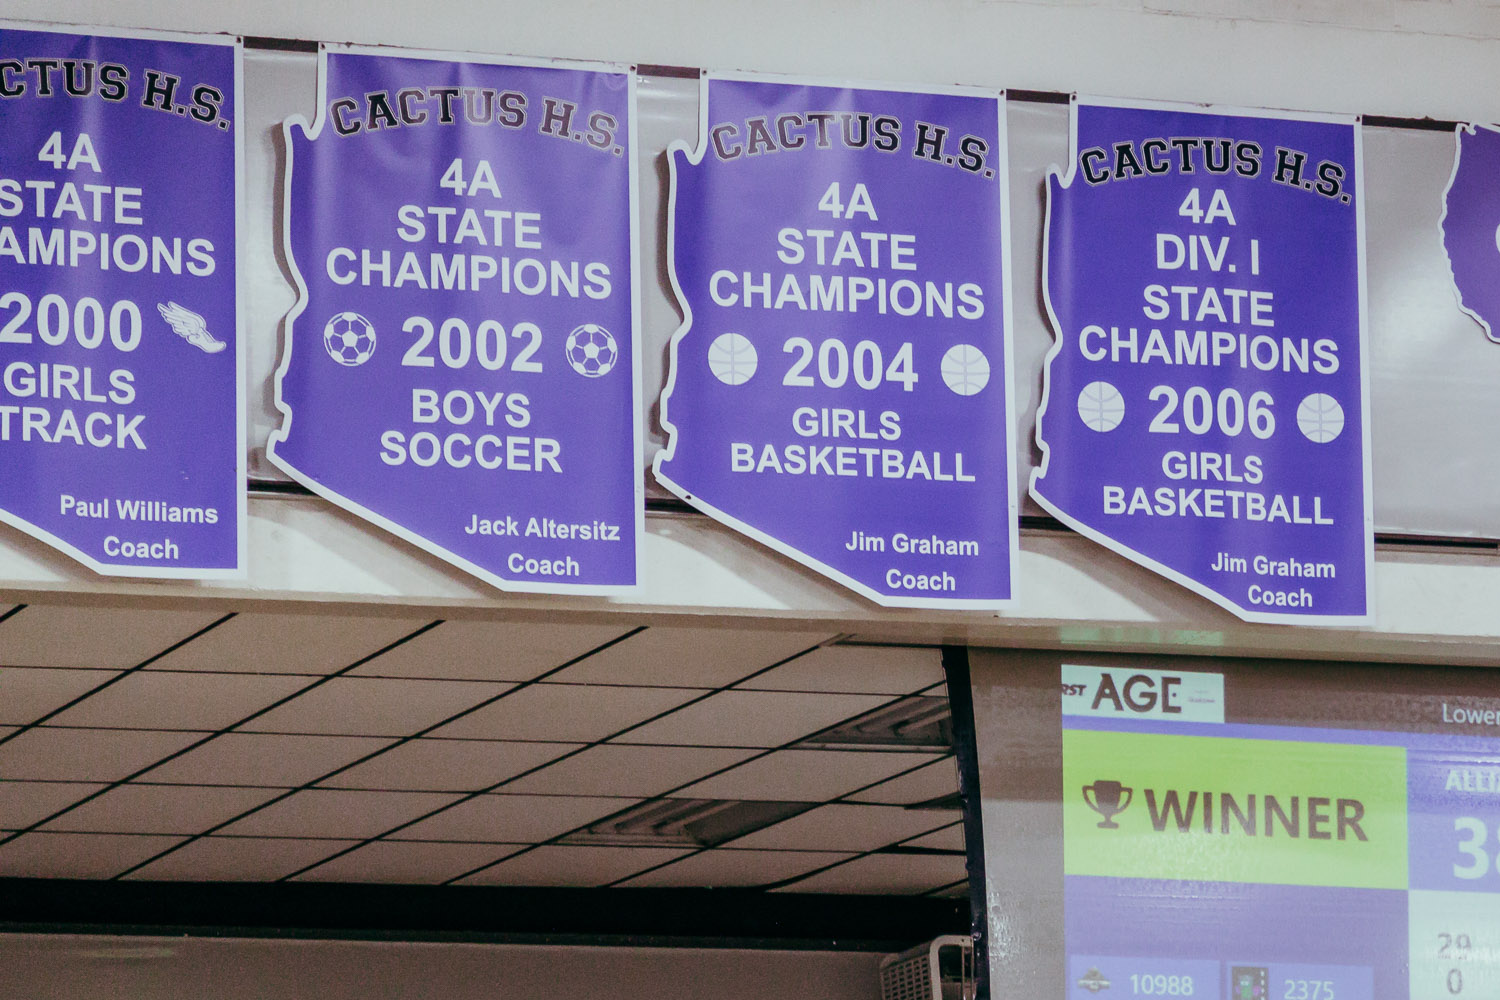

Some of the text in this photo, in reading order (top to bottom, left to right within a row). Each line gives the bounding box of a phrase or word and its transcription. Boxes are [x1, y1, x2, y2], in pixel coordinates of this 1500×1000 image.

[140, 68, 230, 132] H.S.
[330, 86, 625, 157] CACTUS H.S.
[38, 131, 102, 172] 4A
[710, 111, 997, 180] CACTUS H.S.
[439, 159, 502, 198] 4A
[1079, 136, 1353, 205] CACTUS H.S.
[0, 178, 144, 225] STATE
[818, 182, 879, 222] 4A
[1178, 187, 1236, 226] 4A
[396, 205, 542, 249] STATE
[776, 228, 917, 272] STATE
[1155, 233, 1261, 275] DIV. I
[325, 247, 612, 299] CHAMPIONS
[708, 270, 986, 320] CHAMPIONS
[1142, 285, 1275, 327] STATE
[0, 291, 142, 352] 2000
[400, 317, 543, 373] 2002
[782, 336, 919, 392] 2004
[1078, 325, 1341, 375] CHAMPIONS
[3, 361, 136, 405] GIRLS
[0, 405, 147, 450] TRACK
[411, 388, 531, 429] BOYS
[791, 406, 902, 440] GIRLS
[1148, 385, 1277, 439] 2006
[378, 430, 563, 473] SOCCER
[730, 444, 977, 483] BASKETBALL
[1161, 452, 1264, 485] GIRLS
[59, 495, 219, 525] Paul Williams
[1101, 487, 1335, 526] BASKETBALL
[103, 536, 179, 559] Coach
[464, 514, 621, 541] Jack Altersitz
[845, 530, 980, 556] Jim Graham
[506, 553, 580, 577] Coach
[885, 568, 957, 592] Coach
[1210, 552, 1337, 580] Jim Graham
[1247, 585, 1313, 608] Coach
[1091, 673, 1182, 713] AGE
[1144, 788, 1369, 843] WINNER
[1129, 974, 1194, 996] 10988
[1284, 979, 1334, 1000] 2375
[1447, 969, 1463, 995] 0
